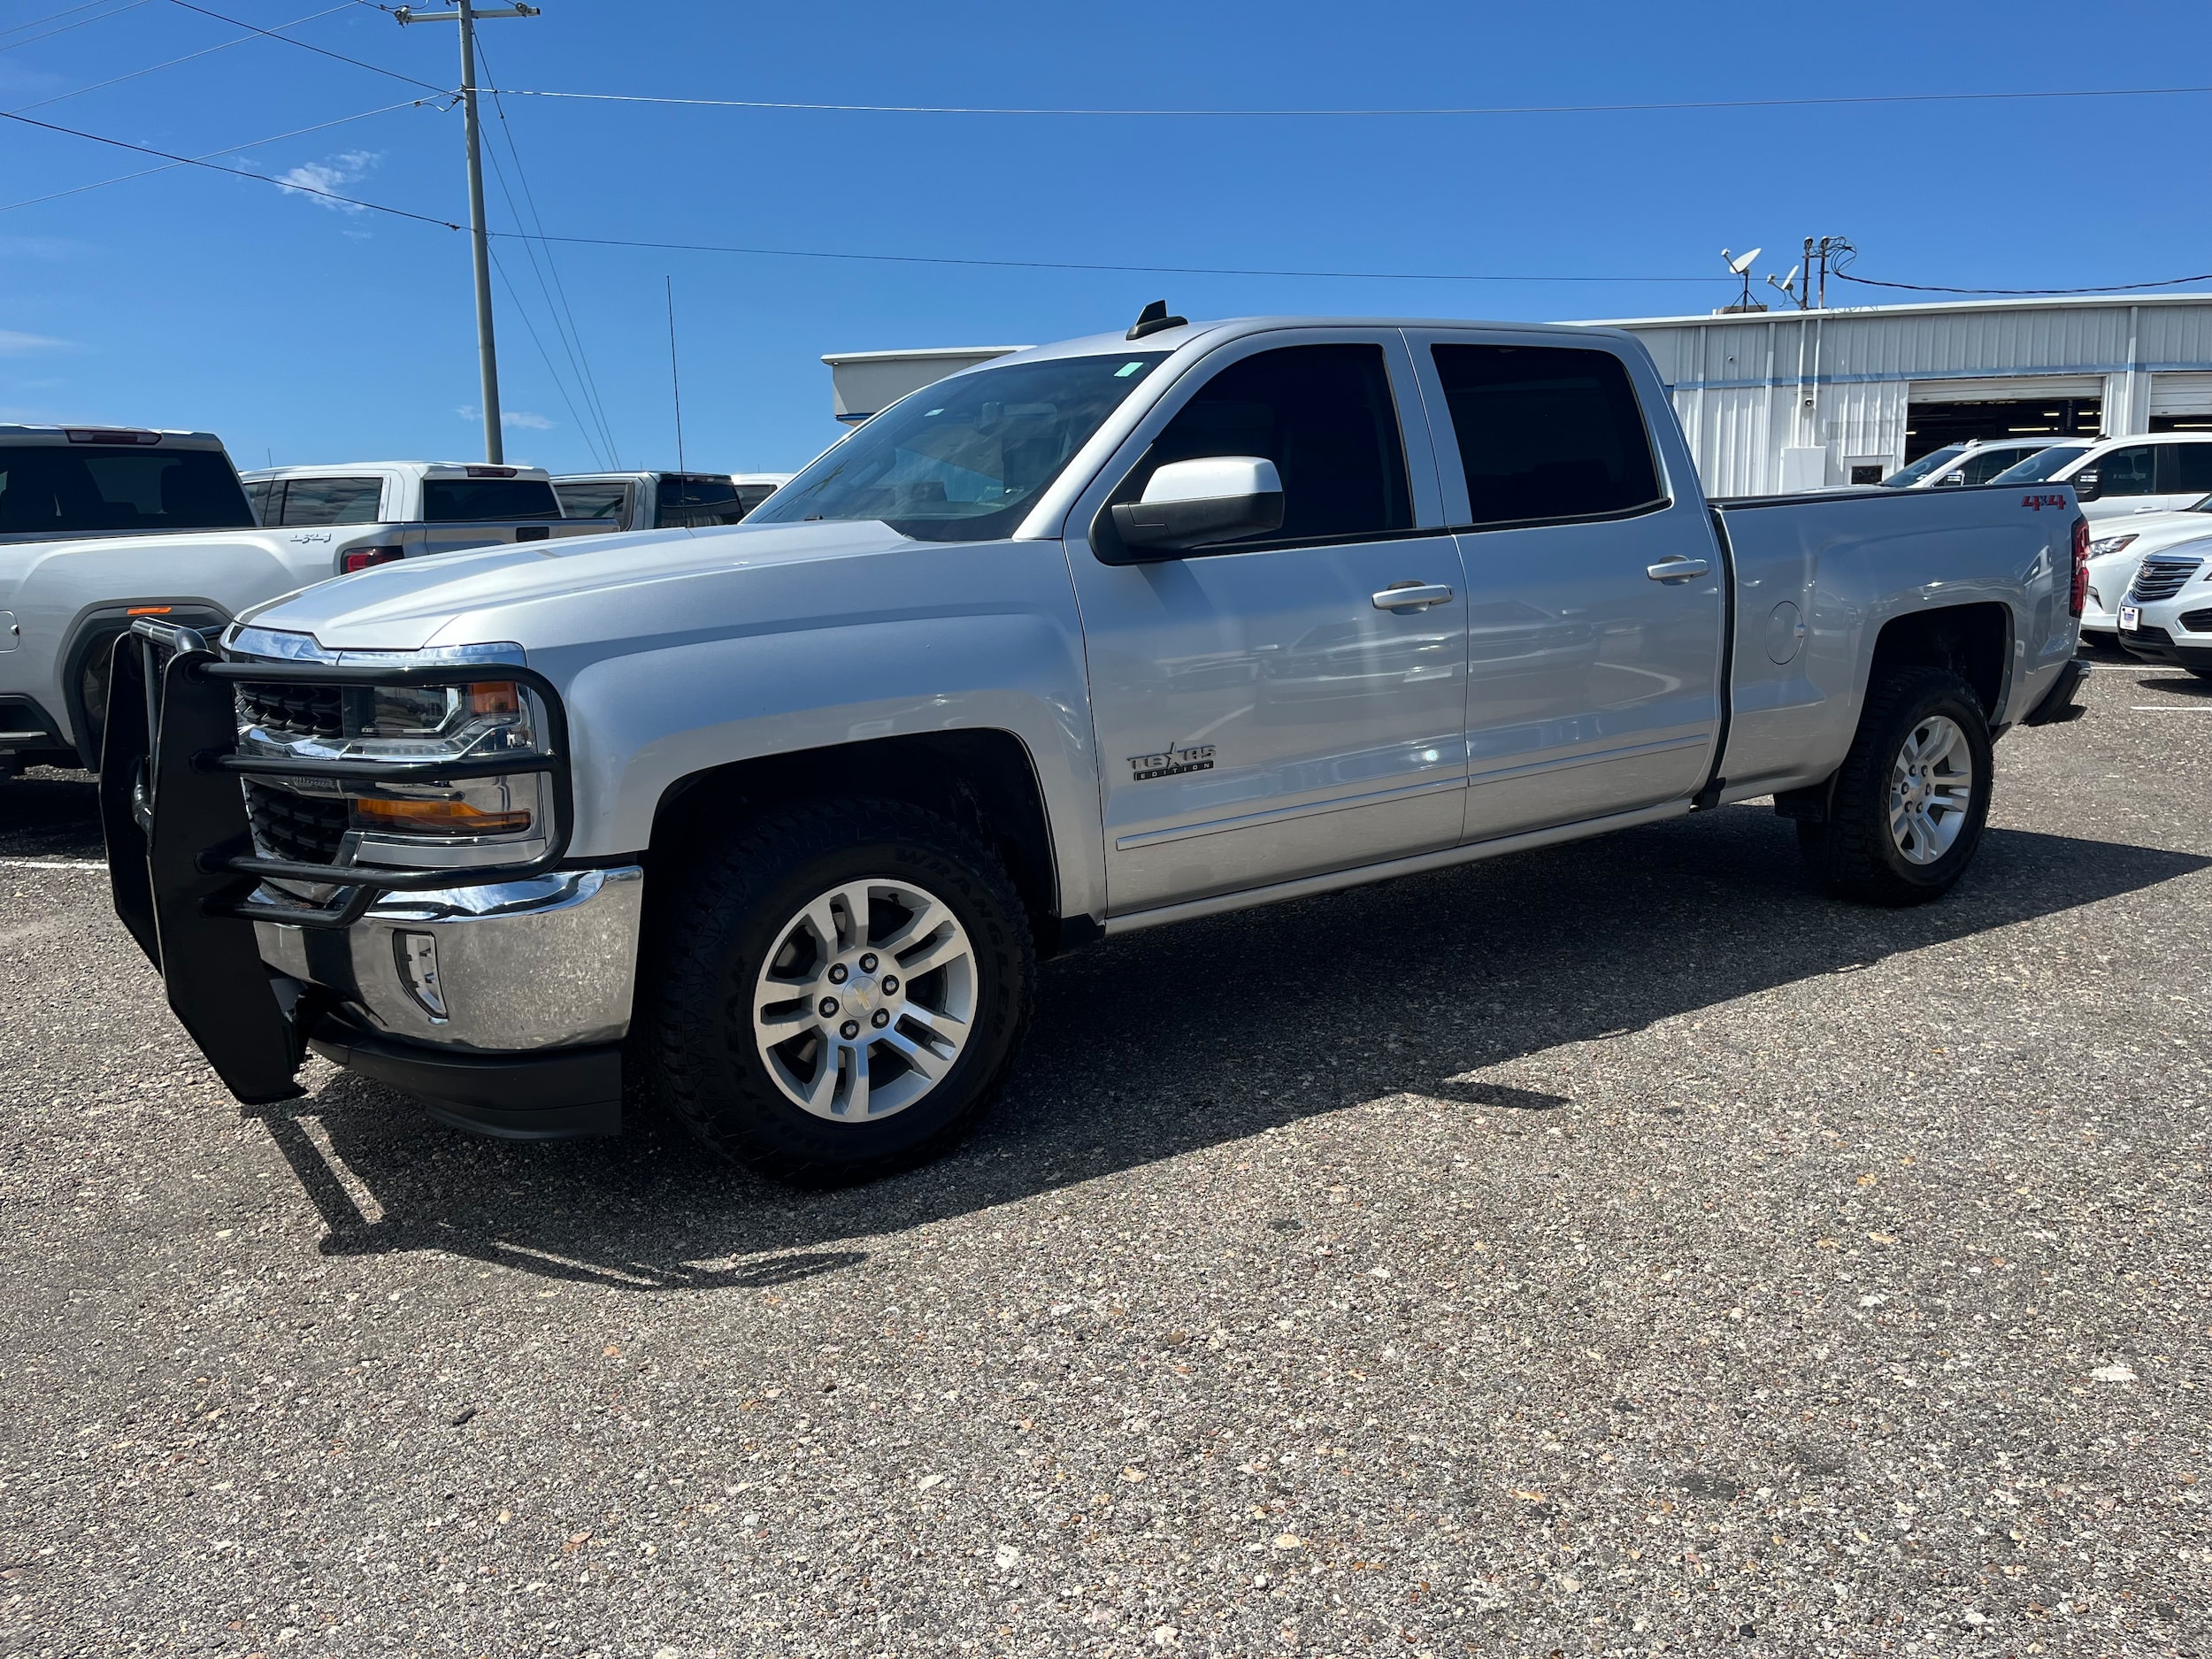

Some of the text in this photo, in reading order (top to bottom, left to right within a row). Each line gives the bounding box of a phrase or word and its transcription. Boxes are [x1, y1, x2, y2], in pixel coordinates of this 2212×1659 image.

[1126, 741, 1217, 770] TEXAS
[1140, 762, 1211, 780] EDITION
[895, 847, 1010, 1039] WRANGLER
